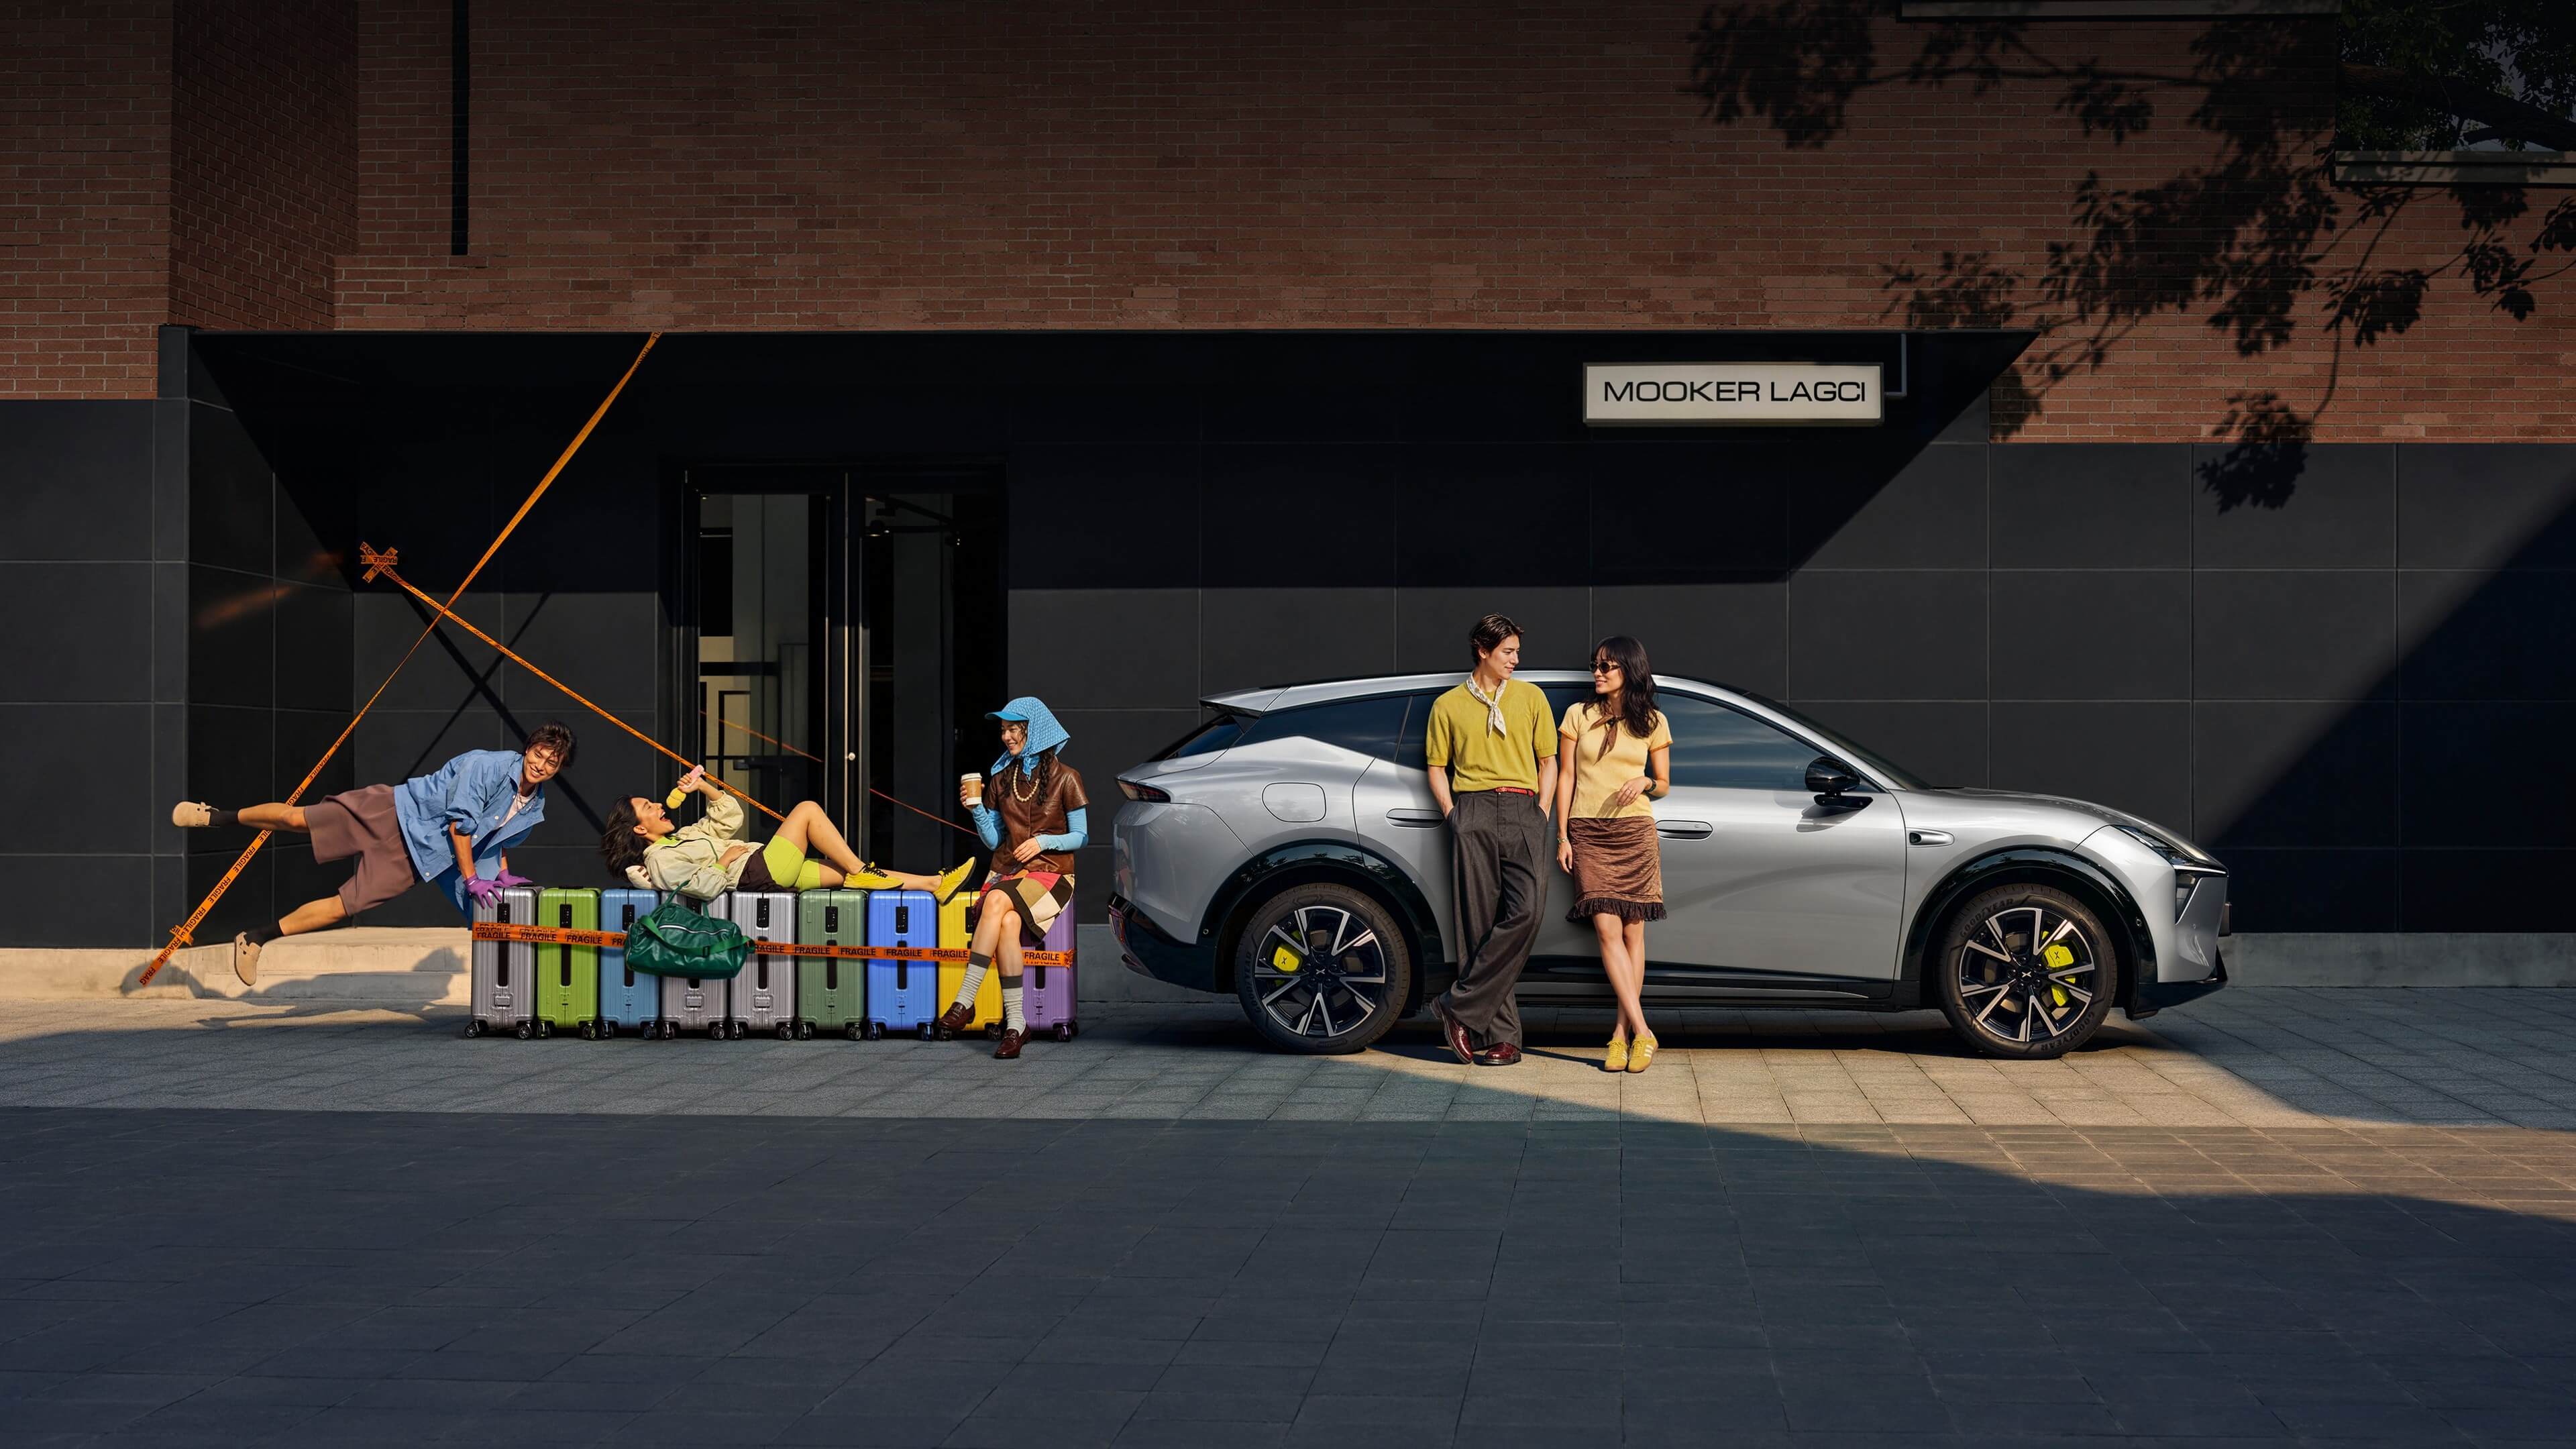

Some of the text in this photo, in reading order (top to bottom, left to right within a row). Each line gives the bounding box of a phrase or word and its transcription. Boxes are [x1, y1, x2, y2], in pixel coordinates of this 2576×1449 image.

[1604, 382, 1866, 402] MOOKER LAGCI
[310, 754, 330, 780] FRAGILE
[287, 786, 304, 806] FRAGI
[140, 846, 256, 985] FRAGILE FRAGILE FRAGILE FRAGILE FRAG
[171, 926, 186, 938] GILE
[521, 933, 557, 942] FRAGILE
[566, 934, 603, 945] FRAGILE
[755, 945, 1060, 961] RAGILE FRAGILE FRAGILE FRAGILE FRAGILE FRAGILE
